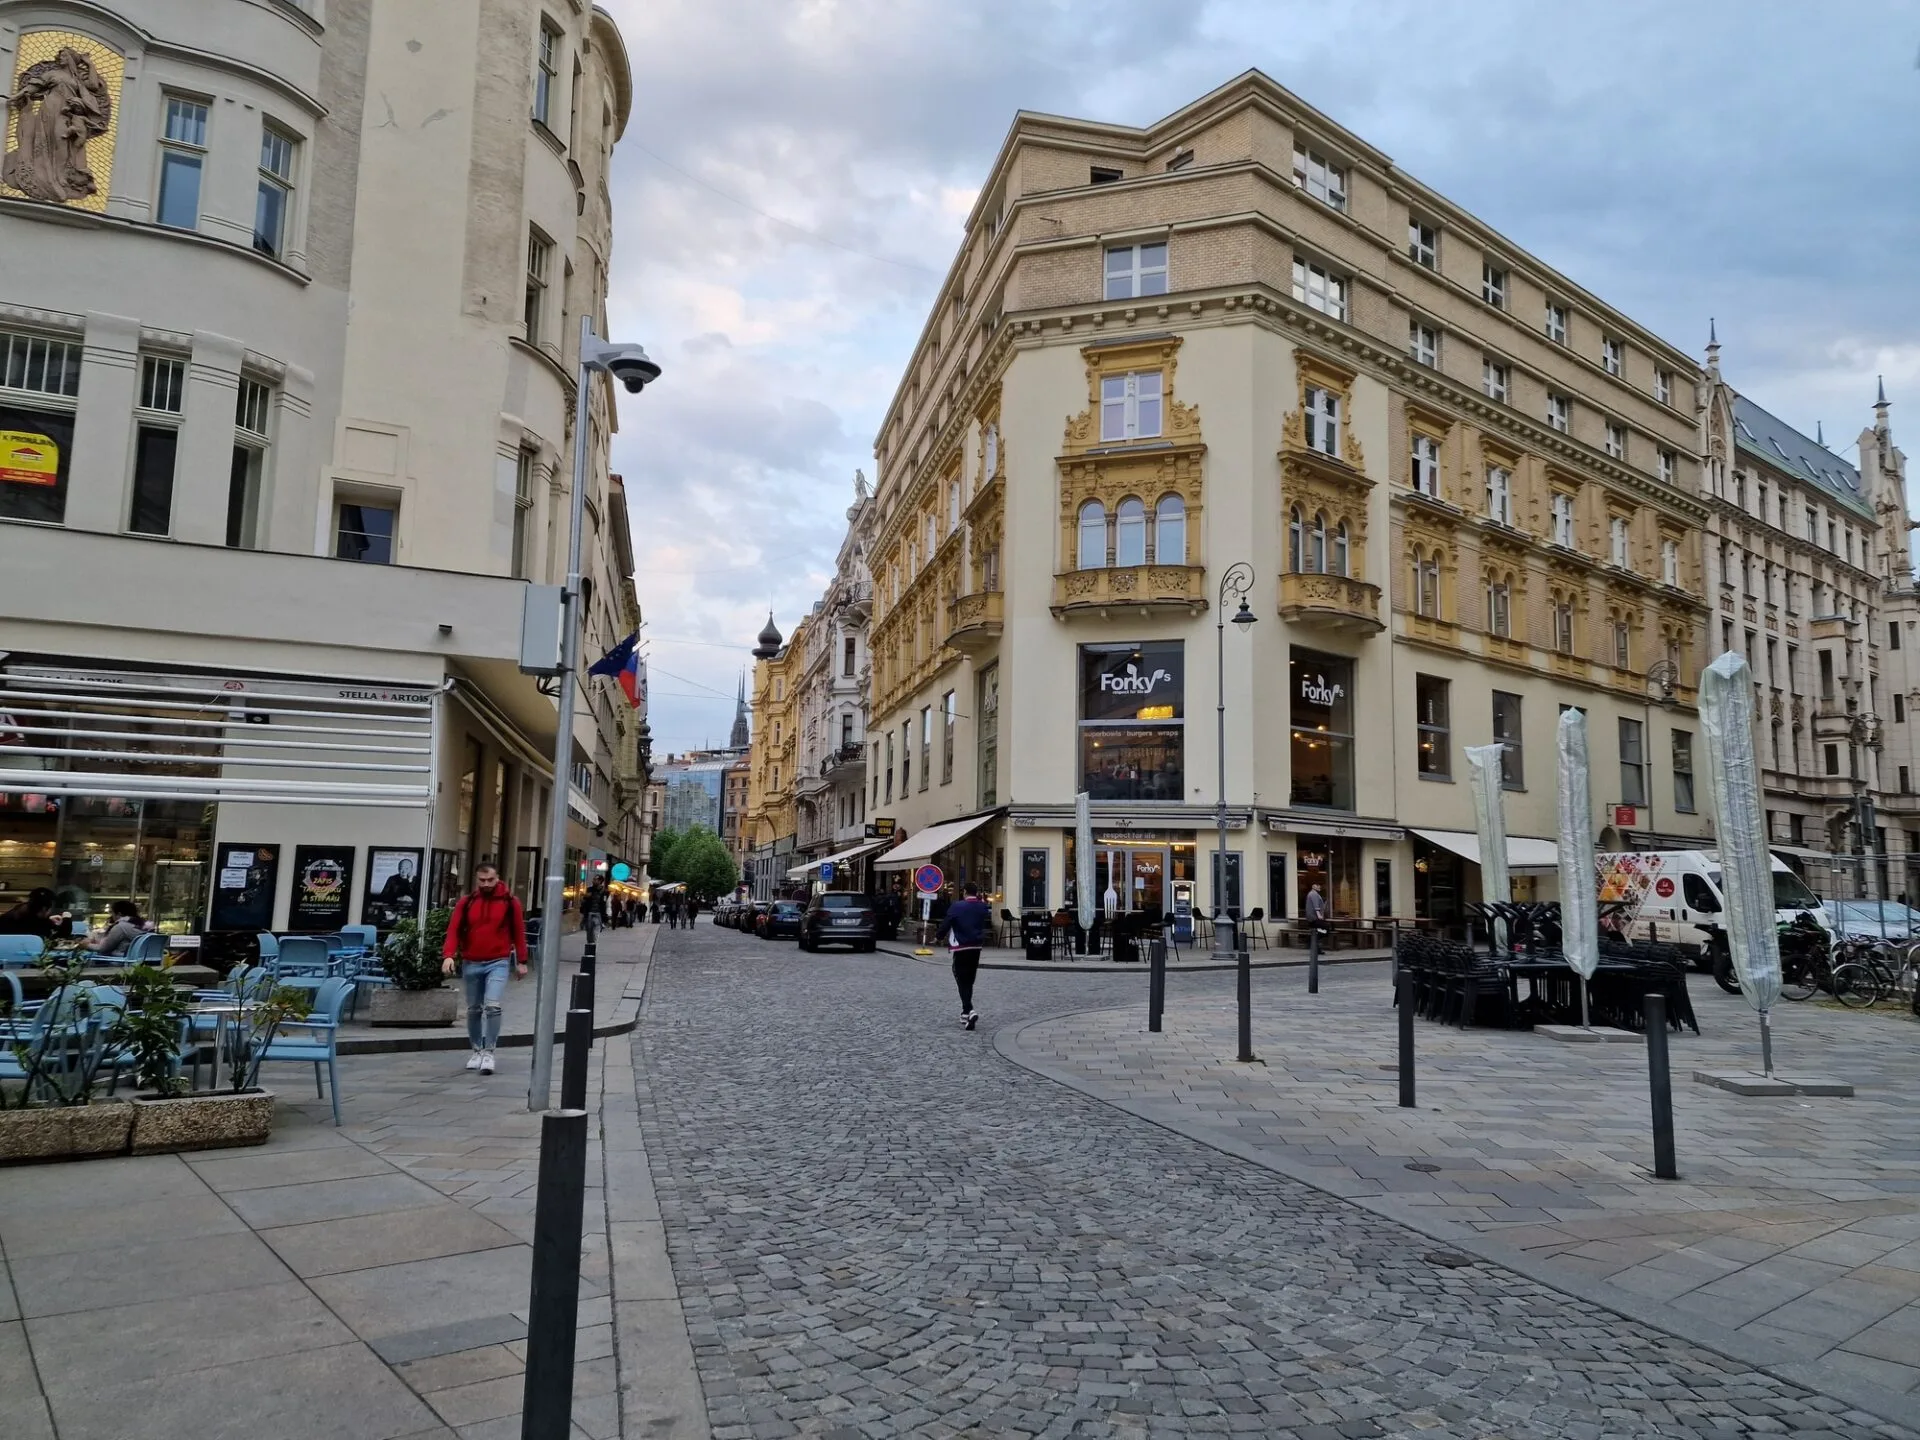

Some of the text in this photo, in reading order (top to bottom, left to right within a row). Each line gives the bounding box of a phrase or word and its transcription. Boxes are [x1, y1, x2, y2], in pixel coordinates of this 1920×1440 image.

[339, 690, 429, 702] STELLA ARTOIS
[824, 864, 831, 875] P
